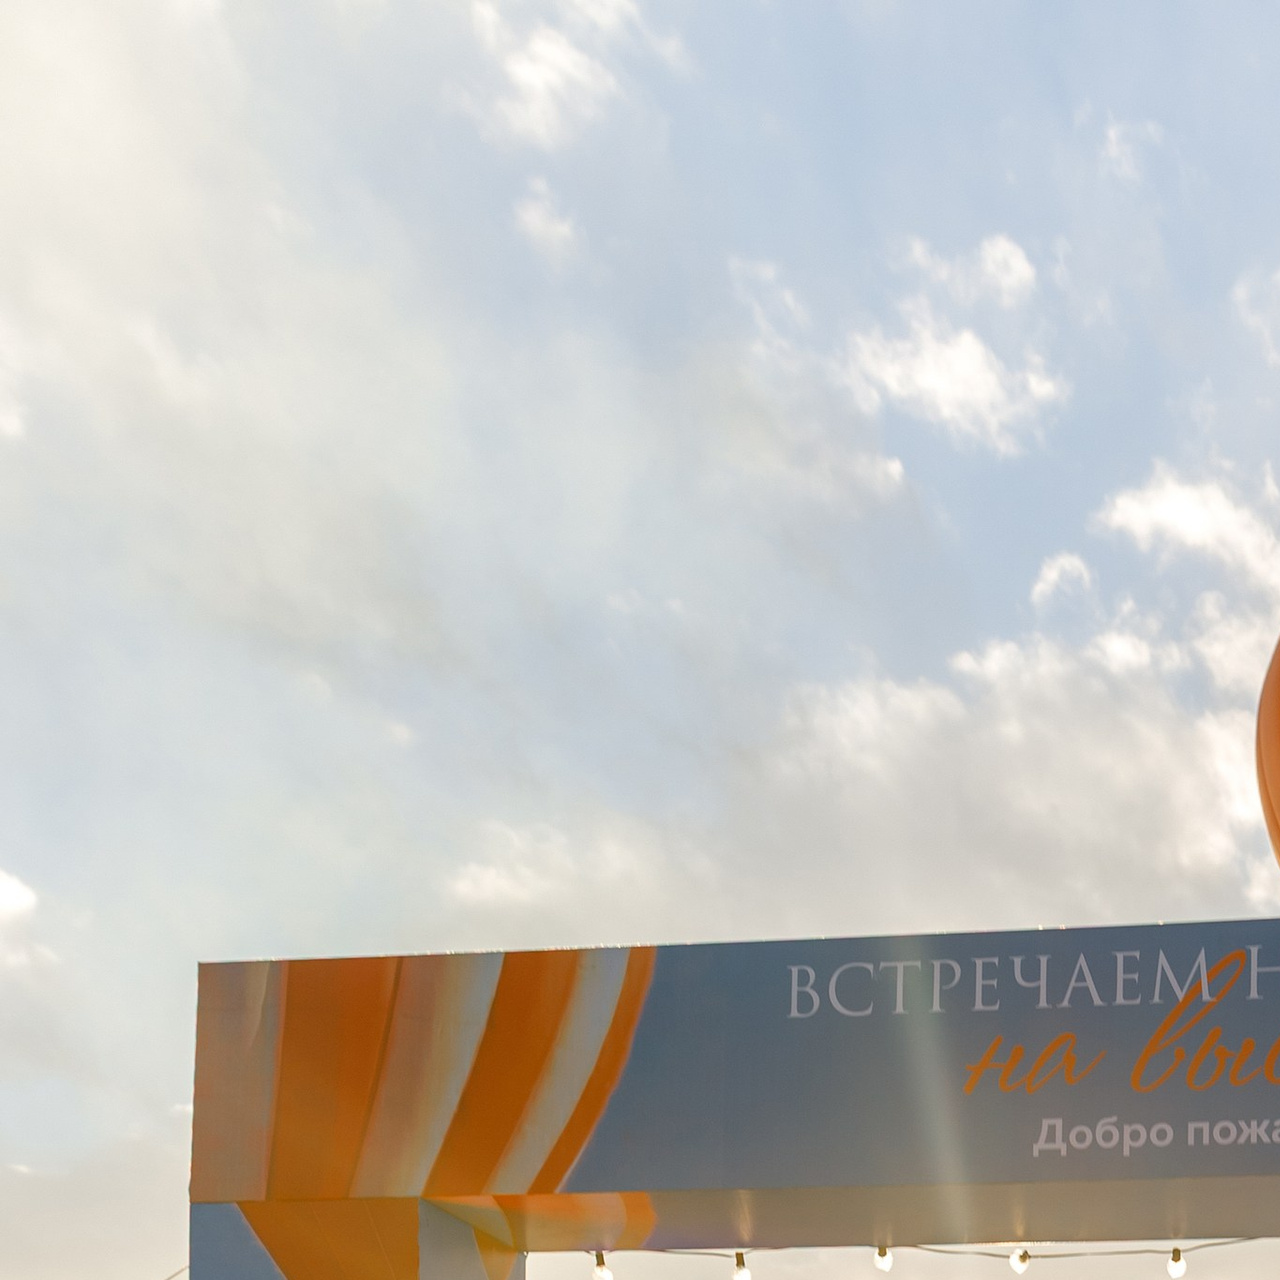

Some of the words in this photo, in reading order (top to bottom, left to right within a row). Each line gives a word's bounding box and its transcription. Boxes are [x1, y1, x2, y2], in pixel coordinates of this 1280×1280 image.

[786, 946, 1220, 1019] ВСТРЕЧАЕМ
[962, 1031, 1106, 1096] на
[1032, 1114, 1175, 1158] Добро
